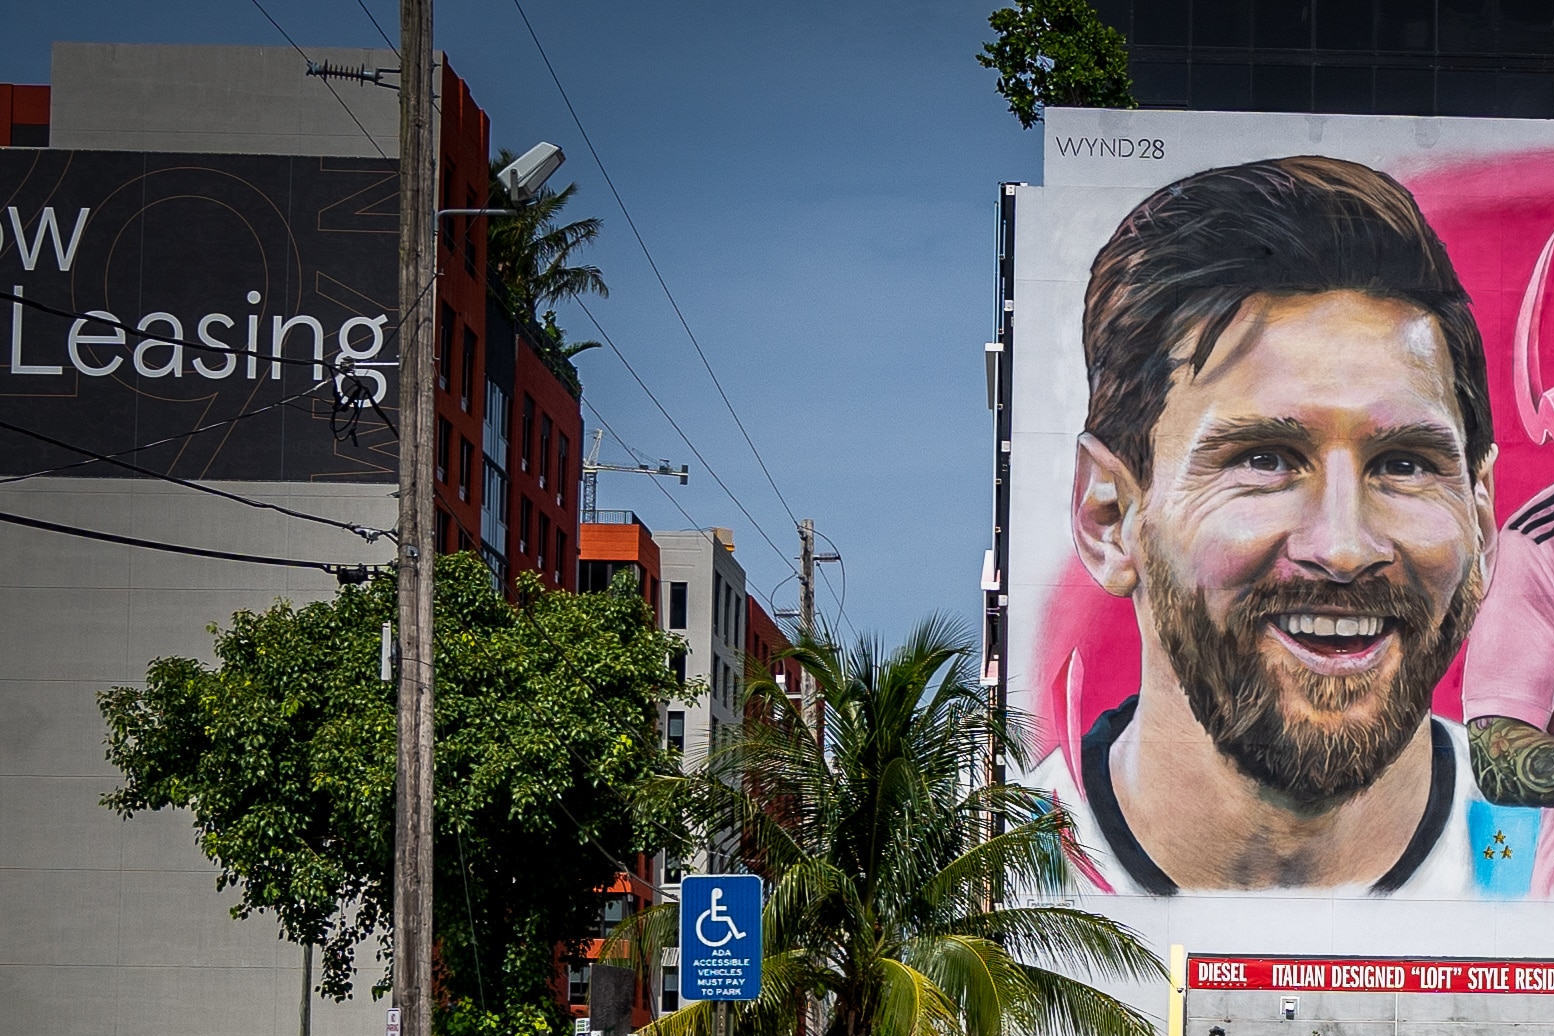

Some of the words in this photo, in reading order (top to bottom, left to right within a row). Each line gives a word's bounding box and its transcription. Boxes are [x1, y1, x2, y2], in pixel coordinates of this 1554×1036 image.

[0, 206, 90, 272] w
[11, 285, 388, 408] Leasing
[711, 949, 732, 957] ADA
[693, 958, 750, 967] ACCESSIBLE
[698, 968, 743, 976] VEHICLES
[1198, 962, 1248, 982] DIESEL
[1272, 964, 1325, 987] ITALIAN
[1331, 965, 1404, 988] DESIGNED
[1467, 967, 1509, 990] STYLE
[697, 978, 723, 986] MUST
[725, 978, 746, 986] PAY
[701, 988, 714, 996] TO
[716, 988, 742, 996] PARK
